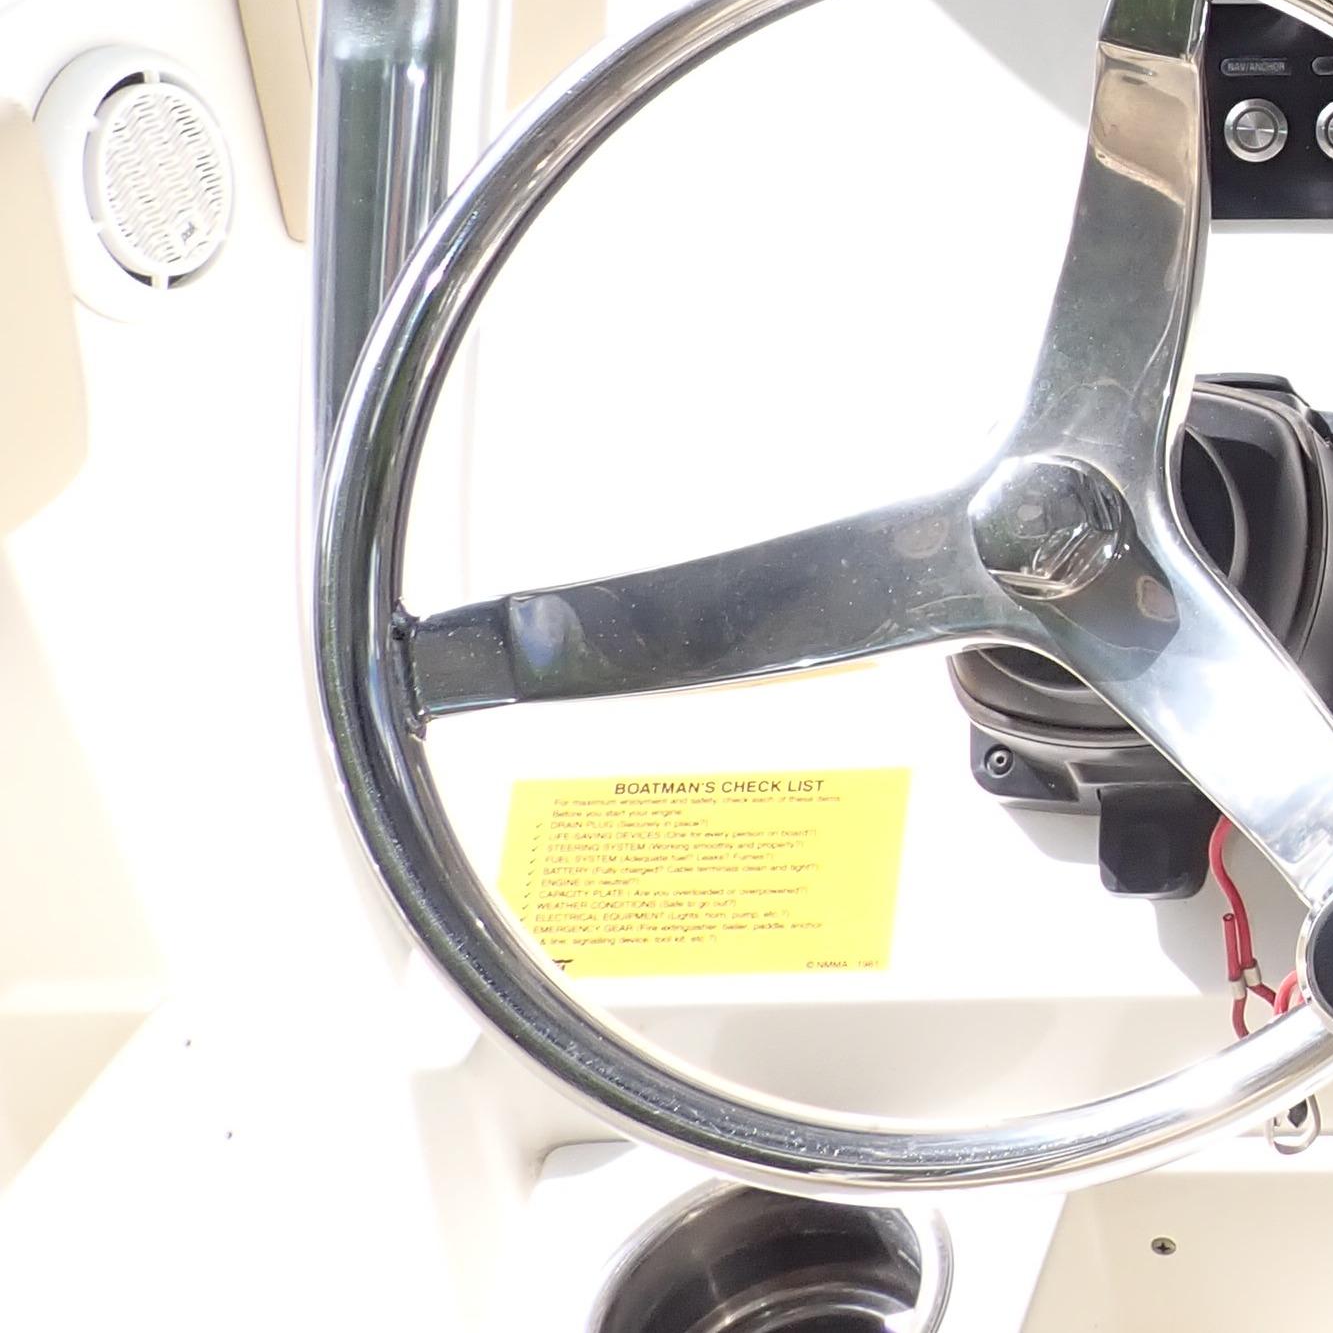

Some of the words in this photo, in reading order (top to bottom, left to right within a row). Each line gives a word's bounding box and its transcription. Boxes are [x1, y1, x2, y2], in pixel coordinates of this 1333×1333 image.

[614, 781, 716, 795] BOATMAN'S
[721, 780, 782, 793] CHECK
[788, 779, 825, 792] LIST
